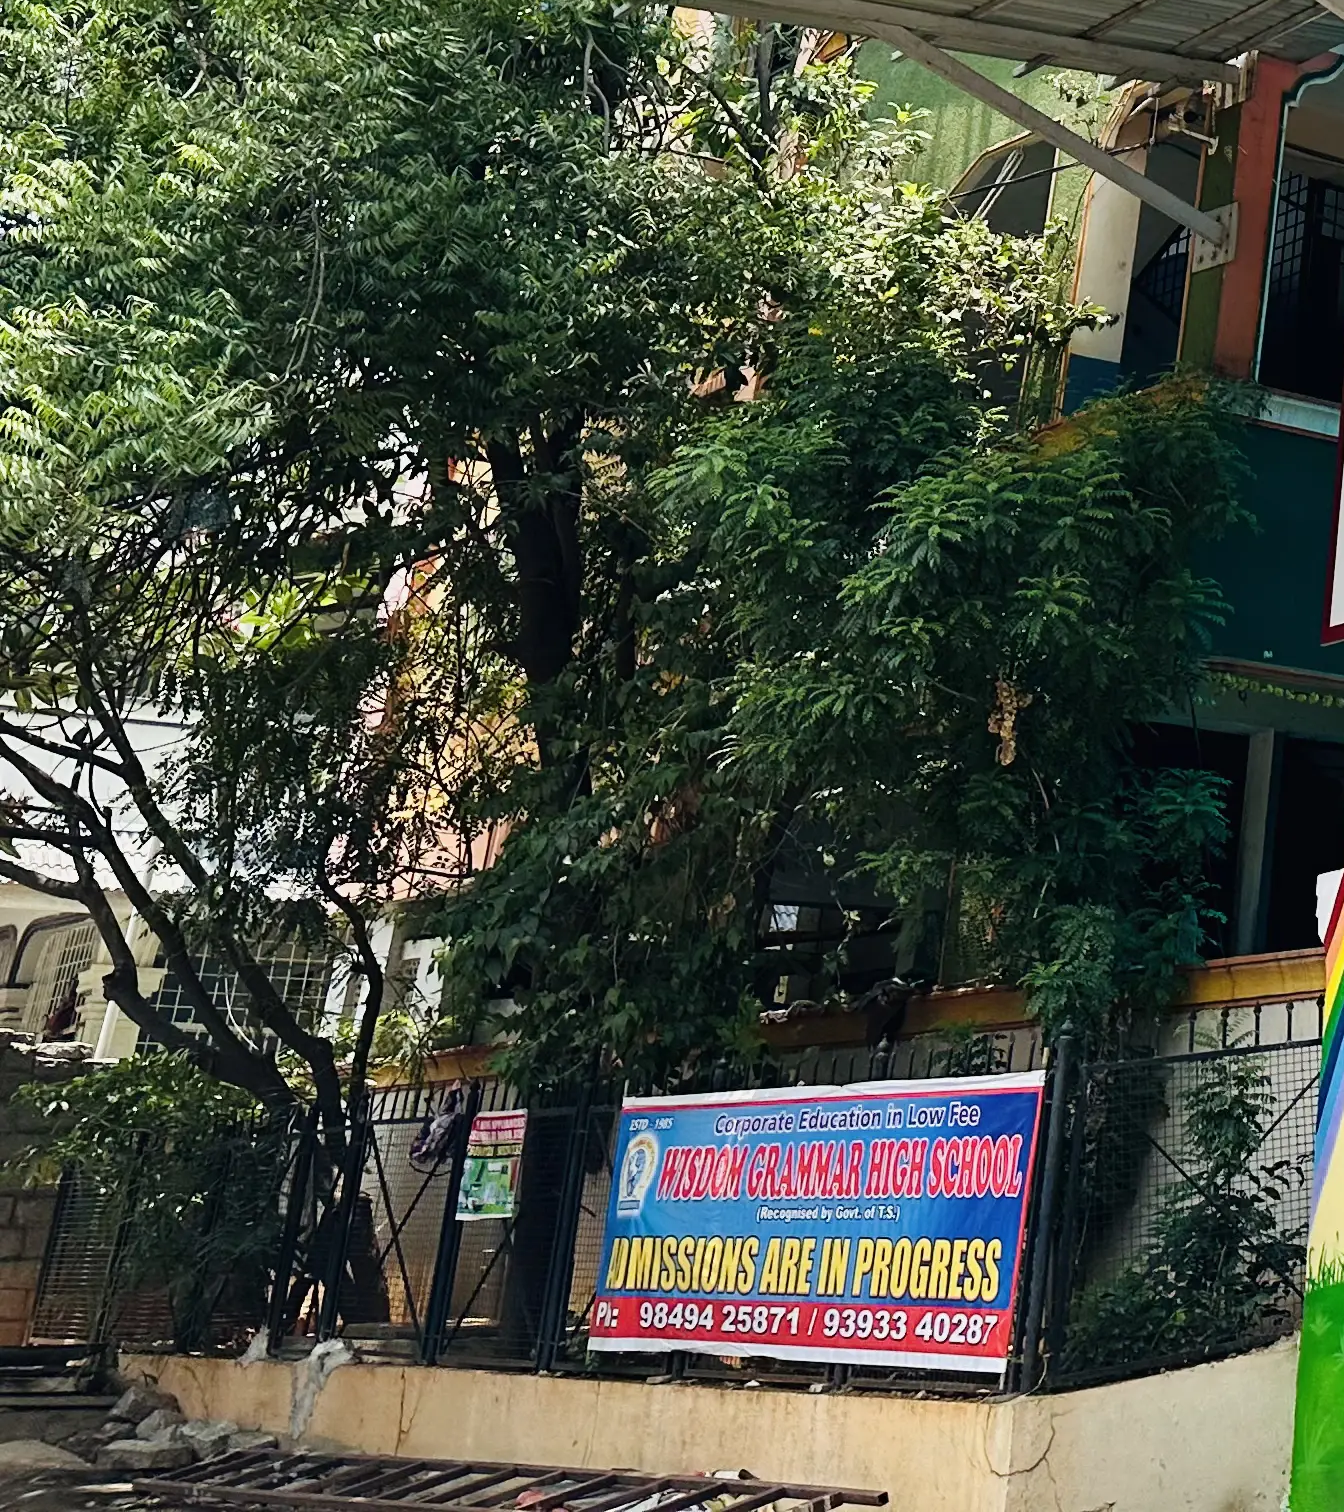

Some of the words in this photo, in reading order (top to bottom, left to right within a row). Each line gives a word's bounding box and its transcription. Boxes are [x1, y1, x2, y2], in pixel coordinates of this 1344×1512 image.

[714, 1112, 794, 1138] Corporate
[797, 1105, 883, 1131] Education
[886, 1103, 904, 1127] in
[907, 1104, 944, 1126] Low
[948, 1102, 981, 1125] Fee
[656, 1144, 747, 1201] WISDOM
[746, 1140, 864, 1199] GRAMMAR
[864, 1136, 929, 1198] HIGH
[928, 1134, 1023, 1199] SCHOOL
[755, 1206, 819, 1223] (Recognised
[820, 1206, 834, 1222] by
[835, 1205, 862, 1221] Govt.
[864, 1205, 876, 1220] of
[877, 1205, 901, 1223] T.S.)
[606, 1235, 760, 1294] ADMISSIONS
[759, 1236, 815, 1296] ARE
[816, 1236, 852, 1297] IN
[854, 1236, 1002, 1303] PROGRESS
[639, 1303, 715, 1333] 98494
[720, 1304, 800, 1336] 25871
[823, 1309, 908, 1341] 93933
[914, 1312, 999, 1346] 40287
